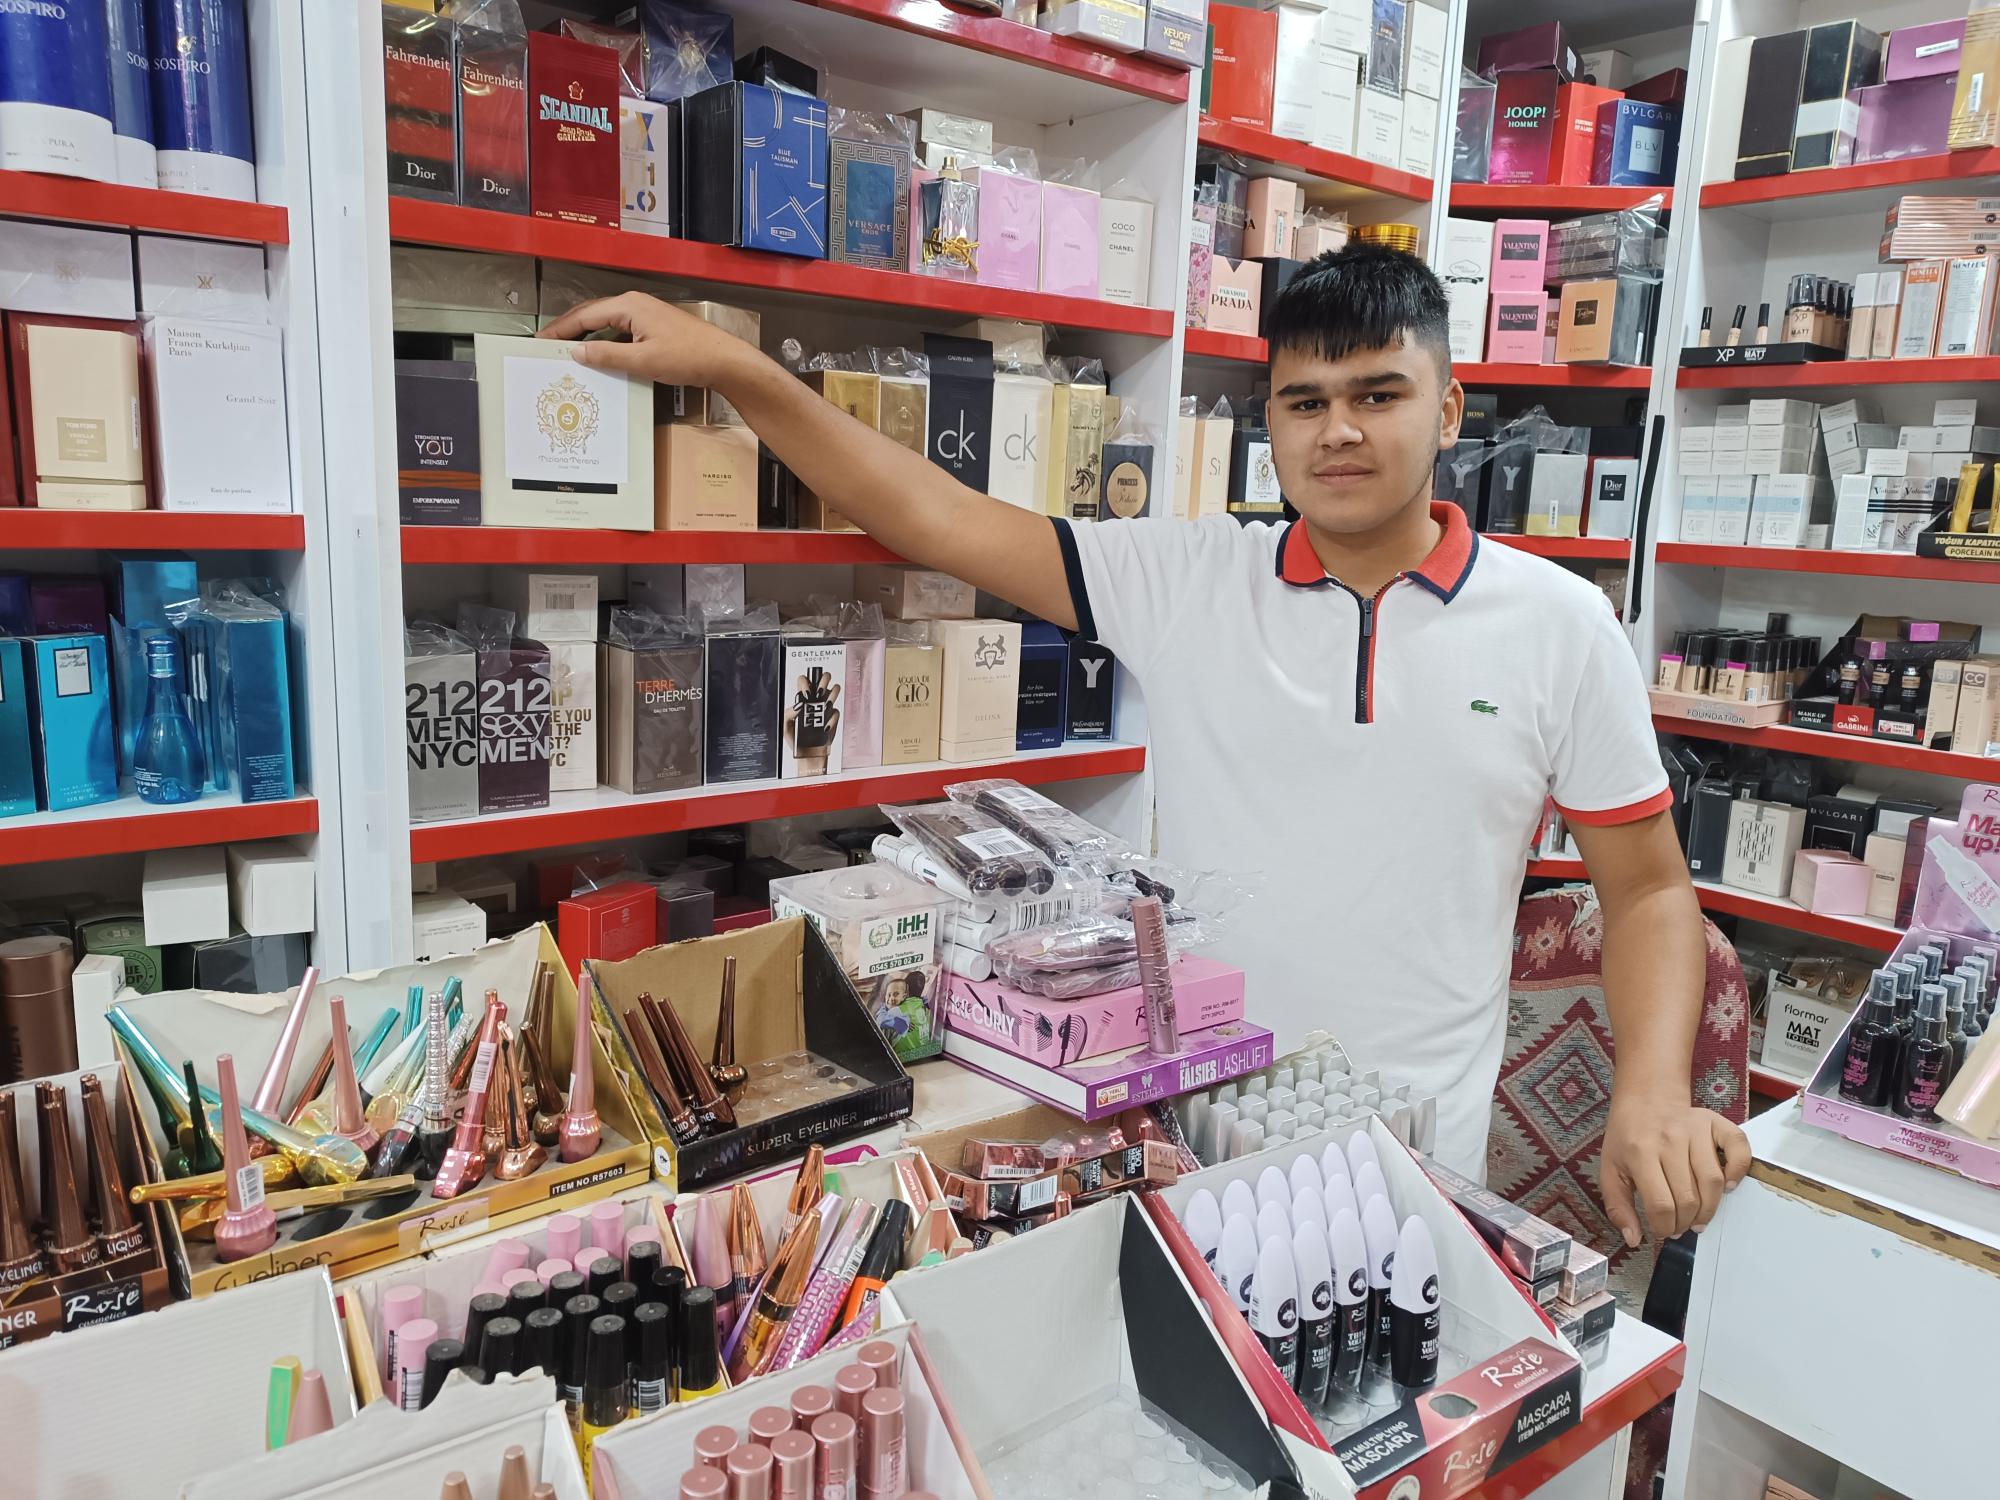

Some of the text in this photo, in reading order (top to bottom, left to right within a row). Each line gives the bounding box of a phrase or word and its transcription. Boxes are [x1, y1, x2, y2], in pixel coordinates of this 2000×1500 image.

[154, 58, 211, 74] SOSPIRO
[385, 45, 451, 72] Fahrenheit
[463, 64, 525, 92] Fahrenheit
[540, 93, 613, 134] SCANDAL
[1503, 106, 1547, 120] JOOP!
[1508, 120, 1539, 128] HOMME
[778, 148, 792, 157] BLUE
[1635, 140, 1659, 151] BLV
[771, 153, 800, 166] TALISMAN
[405, 161, 437, 182] Dior
[483, 177, 512, 197] Dior
[848, 219, 894, 233] VERSACE
[1111, 222, 1136, 232] COCO
[1109, 243, 1136, 253] CHANEL
[1504, 240, 1539, 250] VALENTINO
[1211, 295, 1253, 311] PRADA
[1500, 314, 1537, 324] VALENTINO
[1795, 313, 1809, 322] XP
[168, 327, 202, 341] Maison
[1790, 328, 1810, 337] MATT
[168, 337, 252, 354] Francis Kurkdjian
[169, 347, 193, 358] Paris
[1716, 349, 1736, 362] XP
[1744, 350, 1766, 359] MATT
[226, 394, 256, 405] Grand
[1467, 411, 1486, 419] BOSS
[415, 434, 439, 442] STRONGER
[936, 409, 977, 462] ck
[1003, 412, 1037, 463] ck
[414, 440, 454, 456] YOU
[420, 458, 449, 467] INTENSELY
[953, 459, 963, 469] be
[702, 472, 733, 480] NARCISO
[1449, 463, 1473, 489] Y
[1503, 465, 1521, 491] Y
[1605, 479, 1623, 489] Dior
[1935, 536, 1963, 548] YOĞUN
[1950, 547, 1990, 558] PORCELAIN
[792, 649, 843, 659] GENTLEMAN
[898, 675, 930, 685] ACQUA DI
[1079, 657, 1107, 689] Y
[1963, 670, 1984, 684] CC
[636, 679, 674, 693] TERRE
[895, 682, 931, 703] GIO
[406, 680, 476, 718] 212
[480, 677, 551, 718] 212
[644, 685, 703, 705] D'HERMÈS
[566, 708, 593, 728] YOU
[1687, 710, 1746, 725] FOUNDATION
[406, 715, 477, 744] MEN
[481, 713, 549, 743] sexy
[562, 723, 583, 741] THE
[407, 740, 477, 771] NYC
[480, 733, 551, 764] MEN
[1810, 807, 1863, 822] BVLGARI
[896, 928, 929, 943] BATMAN
[870, 954, 923, 973] 0545 570 02 72
[1784, 1003, 1830, 1026] flormar
[1787, 1020, 1822, 1041] MAT
[1786, 1033, 1820, 1049] TOUCH
[1179, 1062, 1217, 1091] FALSIES
[746, 1111, 858, 1157] SUPER EYELINER
[1889, 1134, 1926, 1153] setting
[552, 1182, 575, 1195] ITEM
[1451, 1178, 1475, 1195] SKY
[420, 1212, 466, 1238] Rose
[106, 1234, 144, 1256] LIQUID
[82, 1246, 100, 1263] LIQ
[65, 1287, 140, 1323] Rose
[78, 1309, 128, 1329] cosmetics
[1479, 1351, 1544, 1388] Rose
[1516, 1391, 1572, 1433] MASCARA
[1355, 1420, 1409, 1455] MULTIPLYING
[1517, 1422, 1535, 1444] ITEM
[1344, 1428, 1419, 1475] MASCARA
